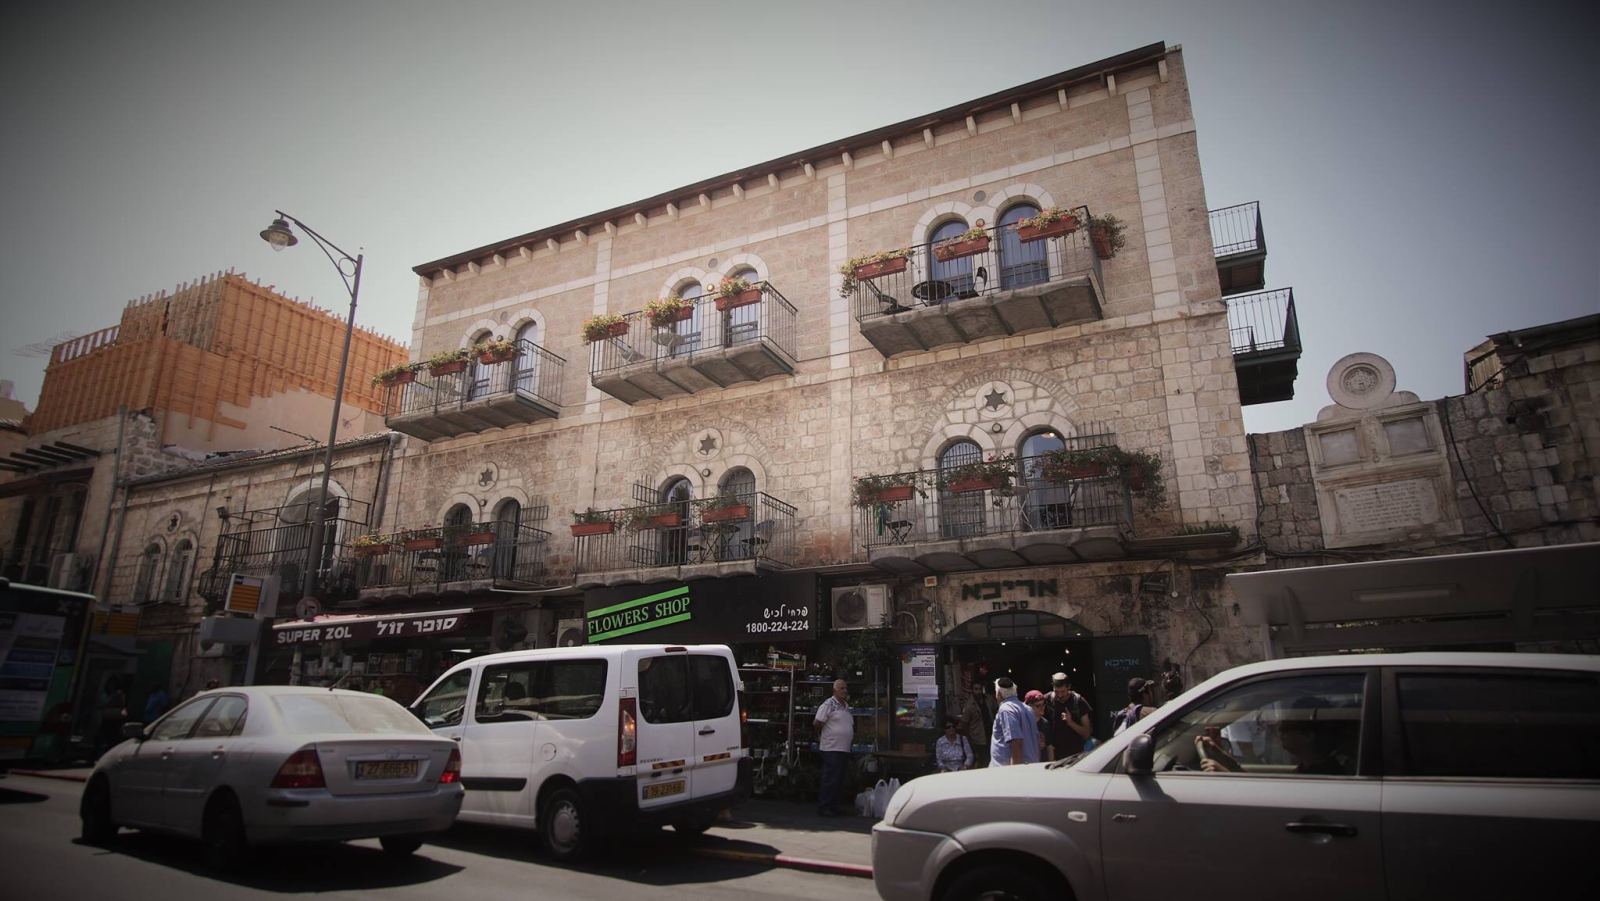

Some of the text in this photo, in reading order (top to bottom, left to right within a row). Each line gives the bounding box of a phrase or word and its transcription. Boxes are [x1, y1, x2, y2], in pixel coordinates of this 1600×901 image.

[763, 604, 808, 619] פרחי לכיש
[992, 601, 1028, 610] סביח
[587, 597, 690, 635] FLOWERS SHOP
[376, 617, 458, 636] סופר זול
[745, 620, 809, 634] 1800-224-224
[277, 626, 352, 644] SUPER ZOL
